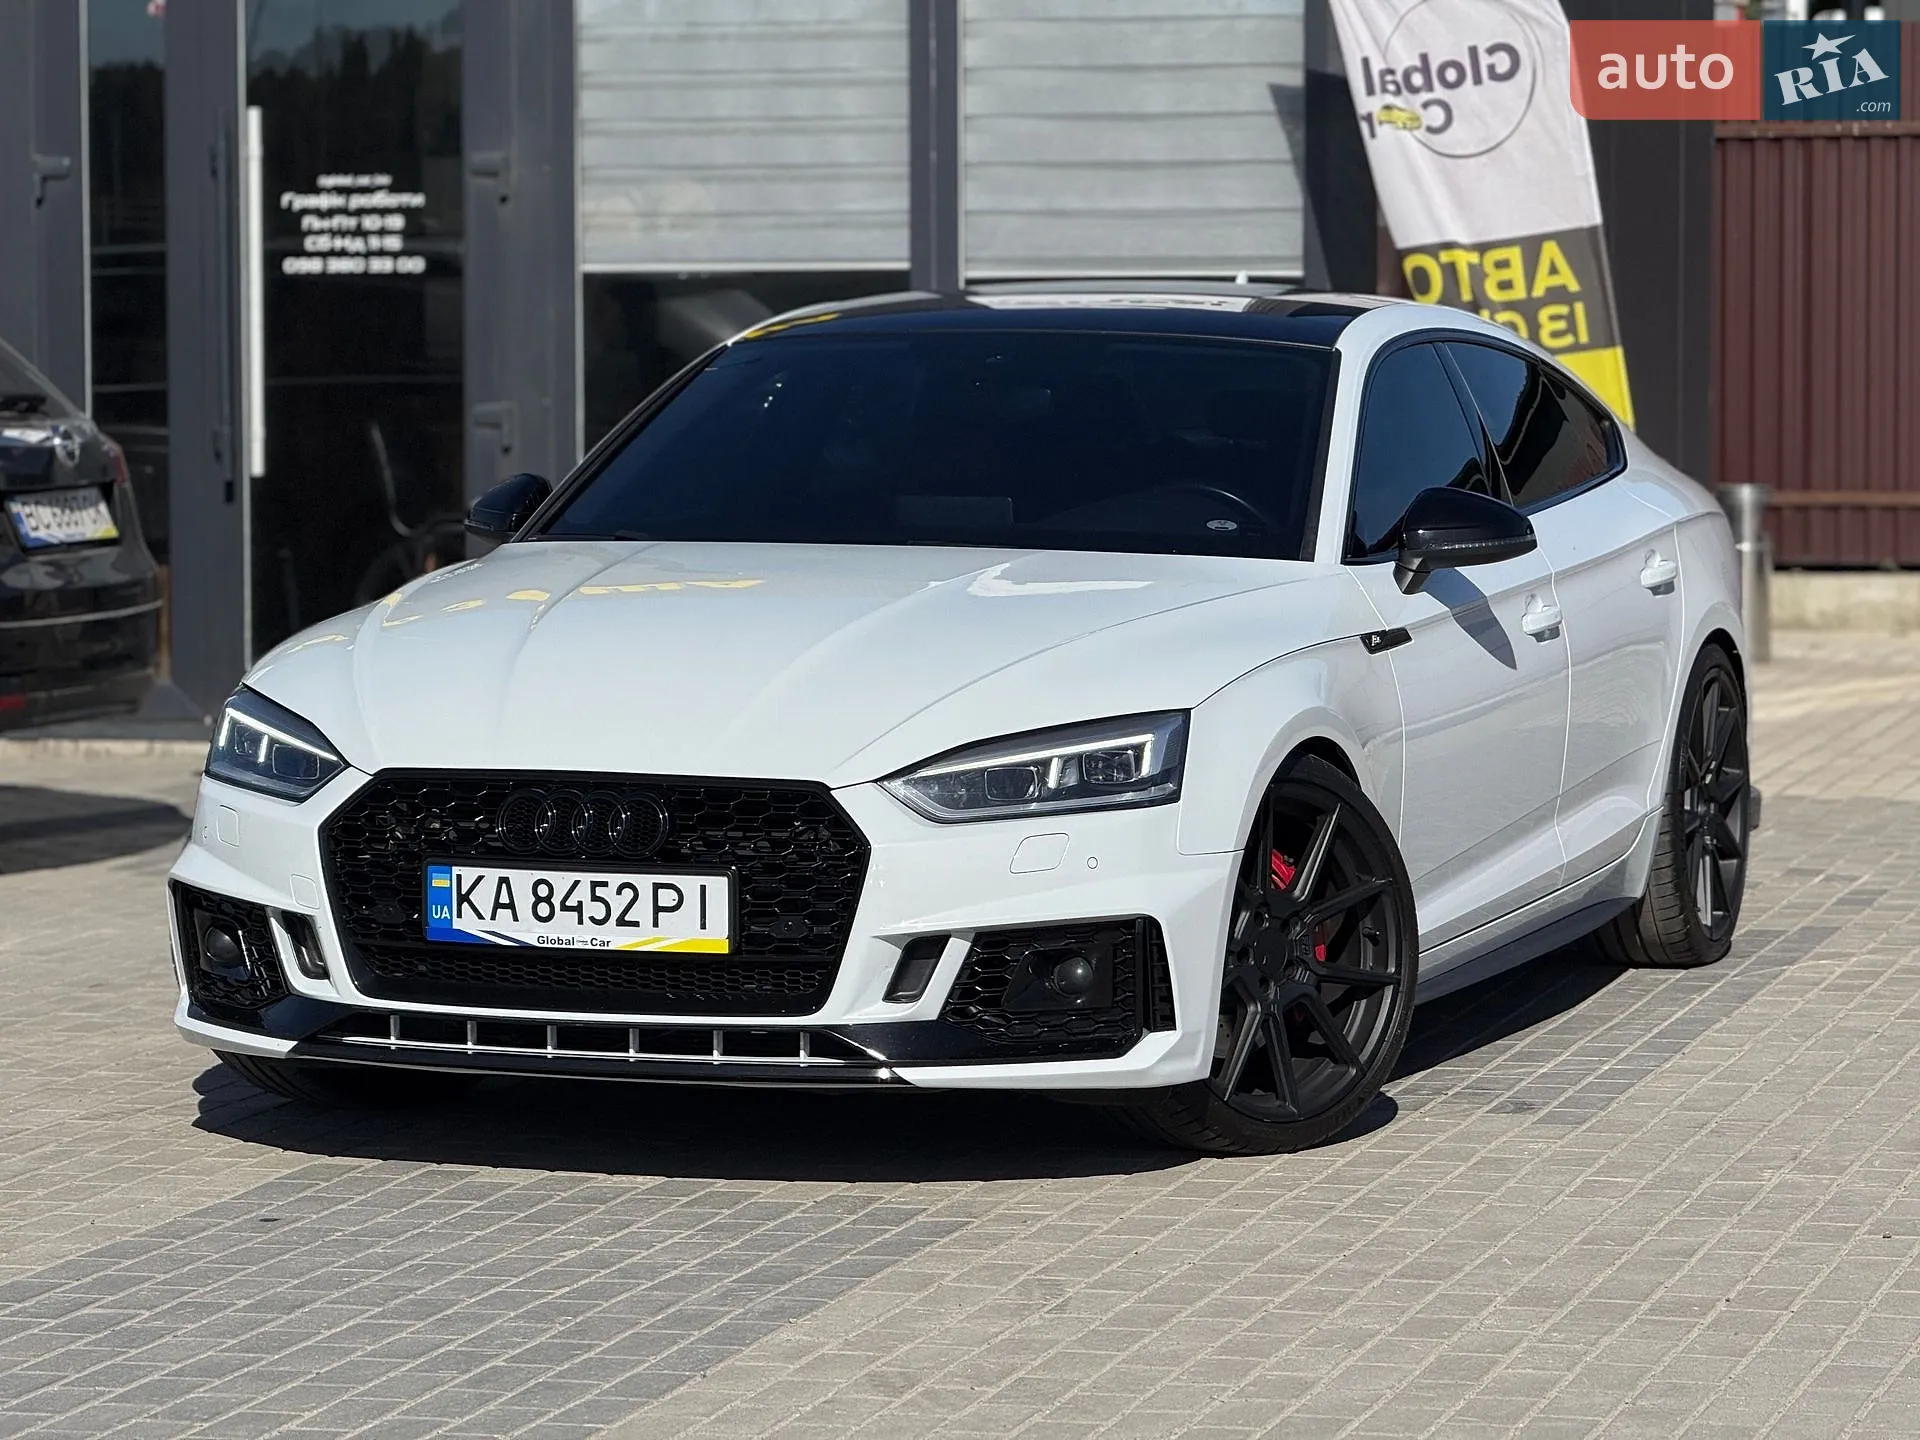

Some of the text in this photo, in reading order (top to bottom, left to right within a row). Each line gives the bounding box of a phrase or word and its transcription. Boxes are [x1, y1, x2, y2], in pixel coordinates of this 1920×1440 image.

[531, 878, 640, 928] 8452
[432, 904, 450, 920] UA
[536, 935, 612, 948] Global Car
